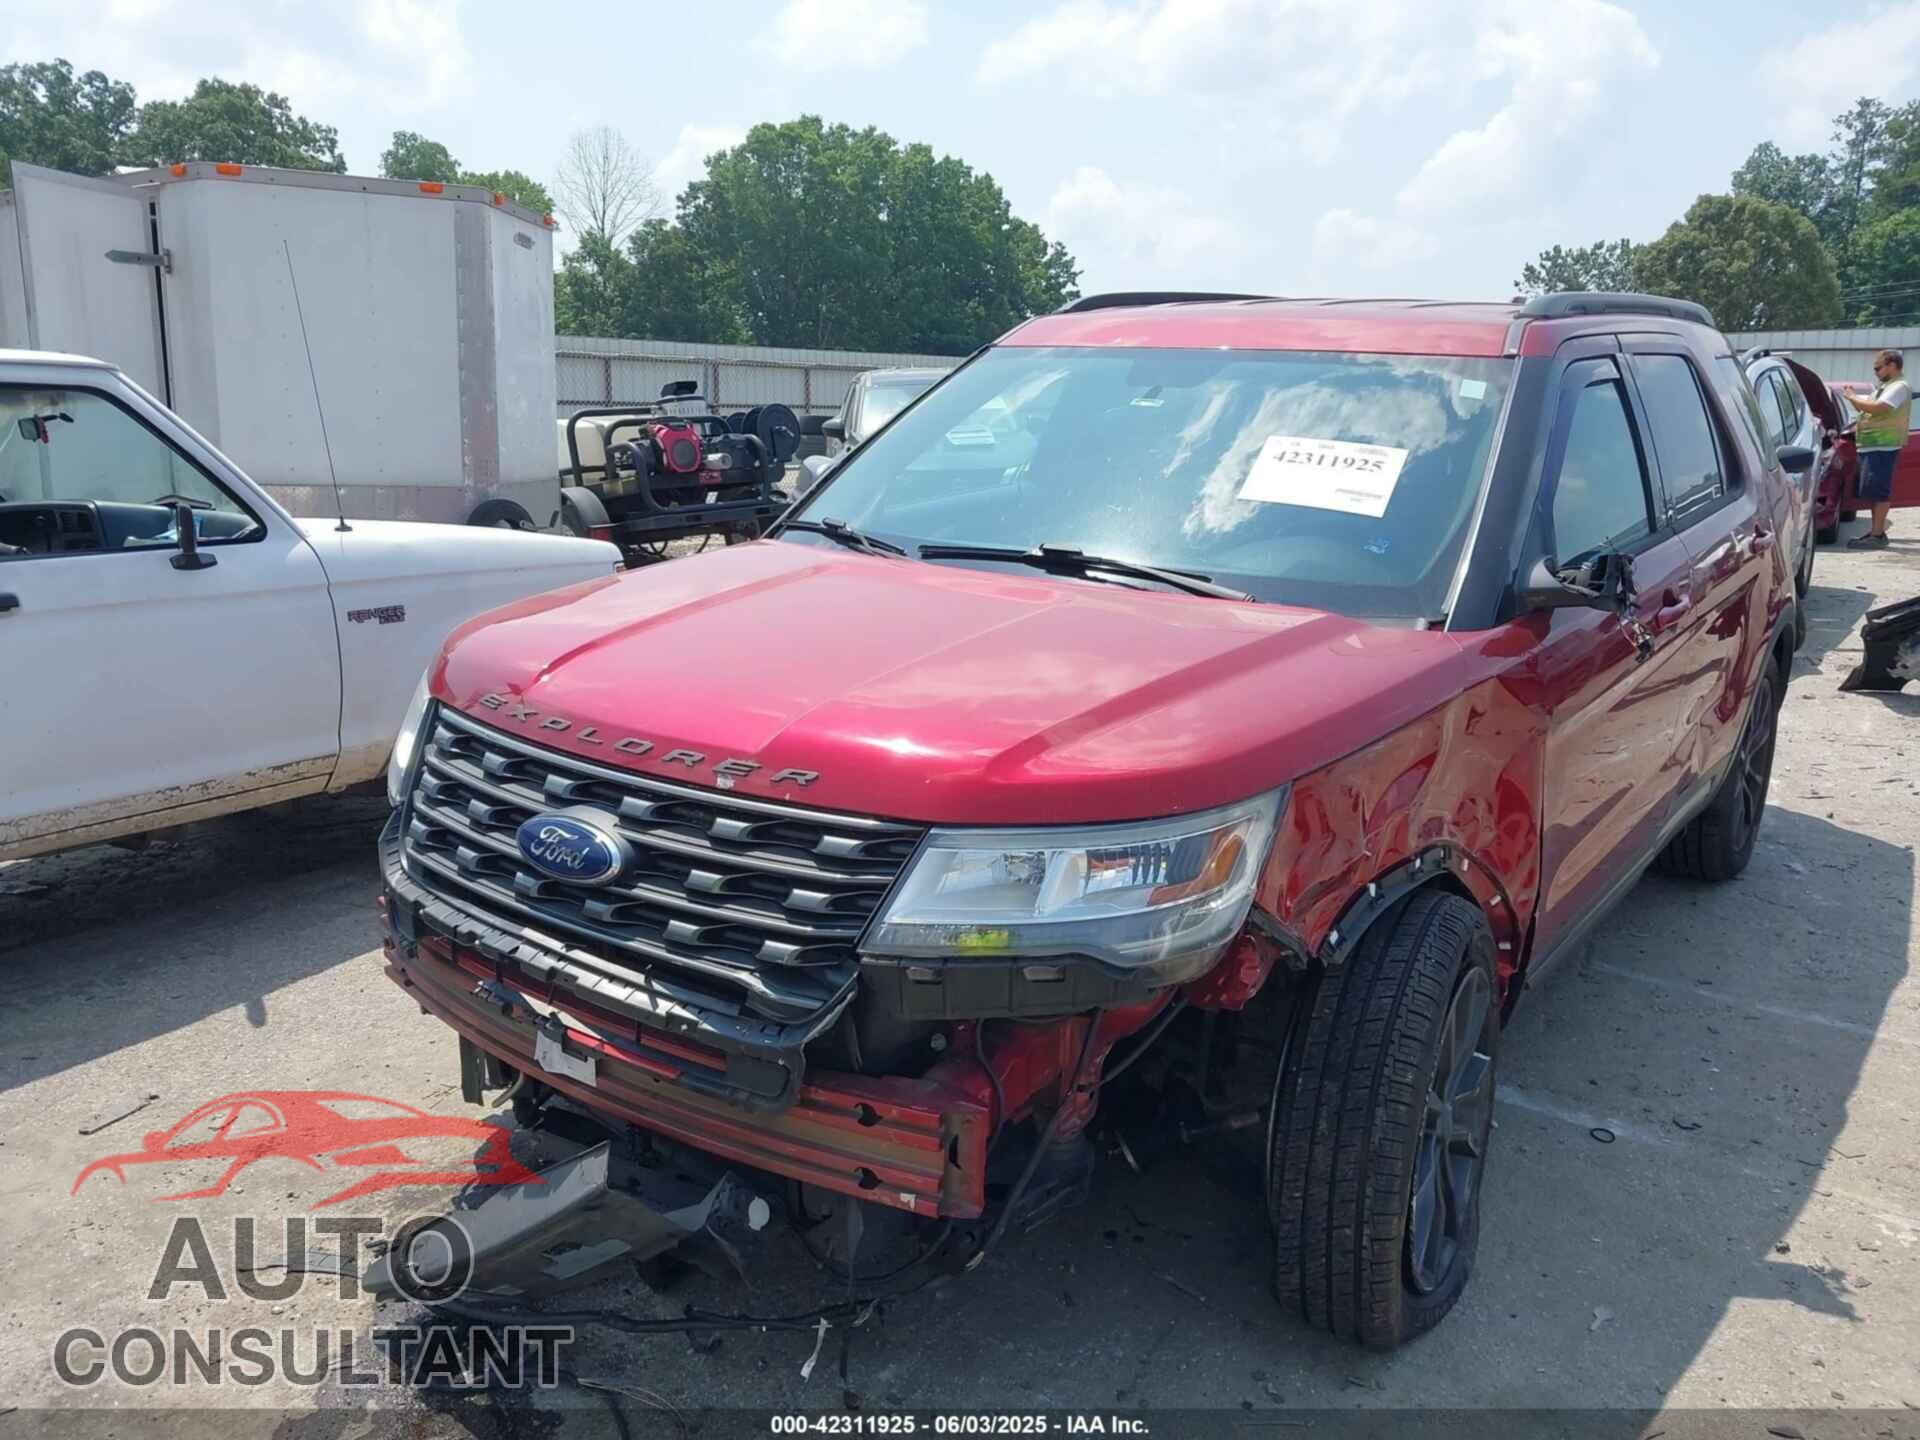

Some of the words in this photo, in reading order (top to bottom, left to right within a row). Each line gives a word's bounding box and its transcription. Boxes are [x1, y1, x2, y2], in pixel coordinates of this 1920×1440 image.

[1273, 450, 1386, 473] 42311925
[479, 693, 820, 786] EXPLORER
[530, 825, 590, 871] Ford
